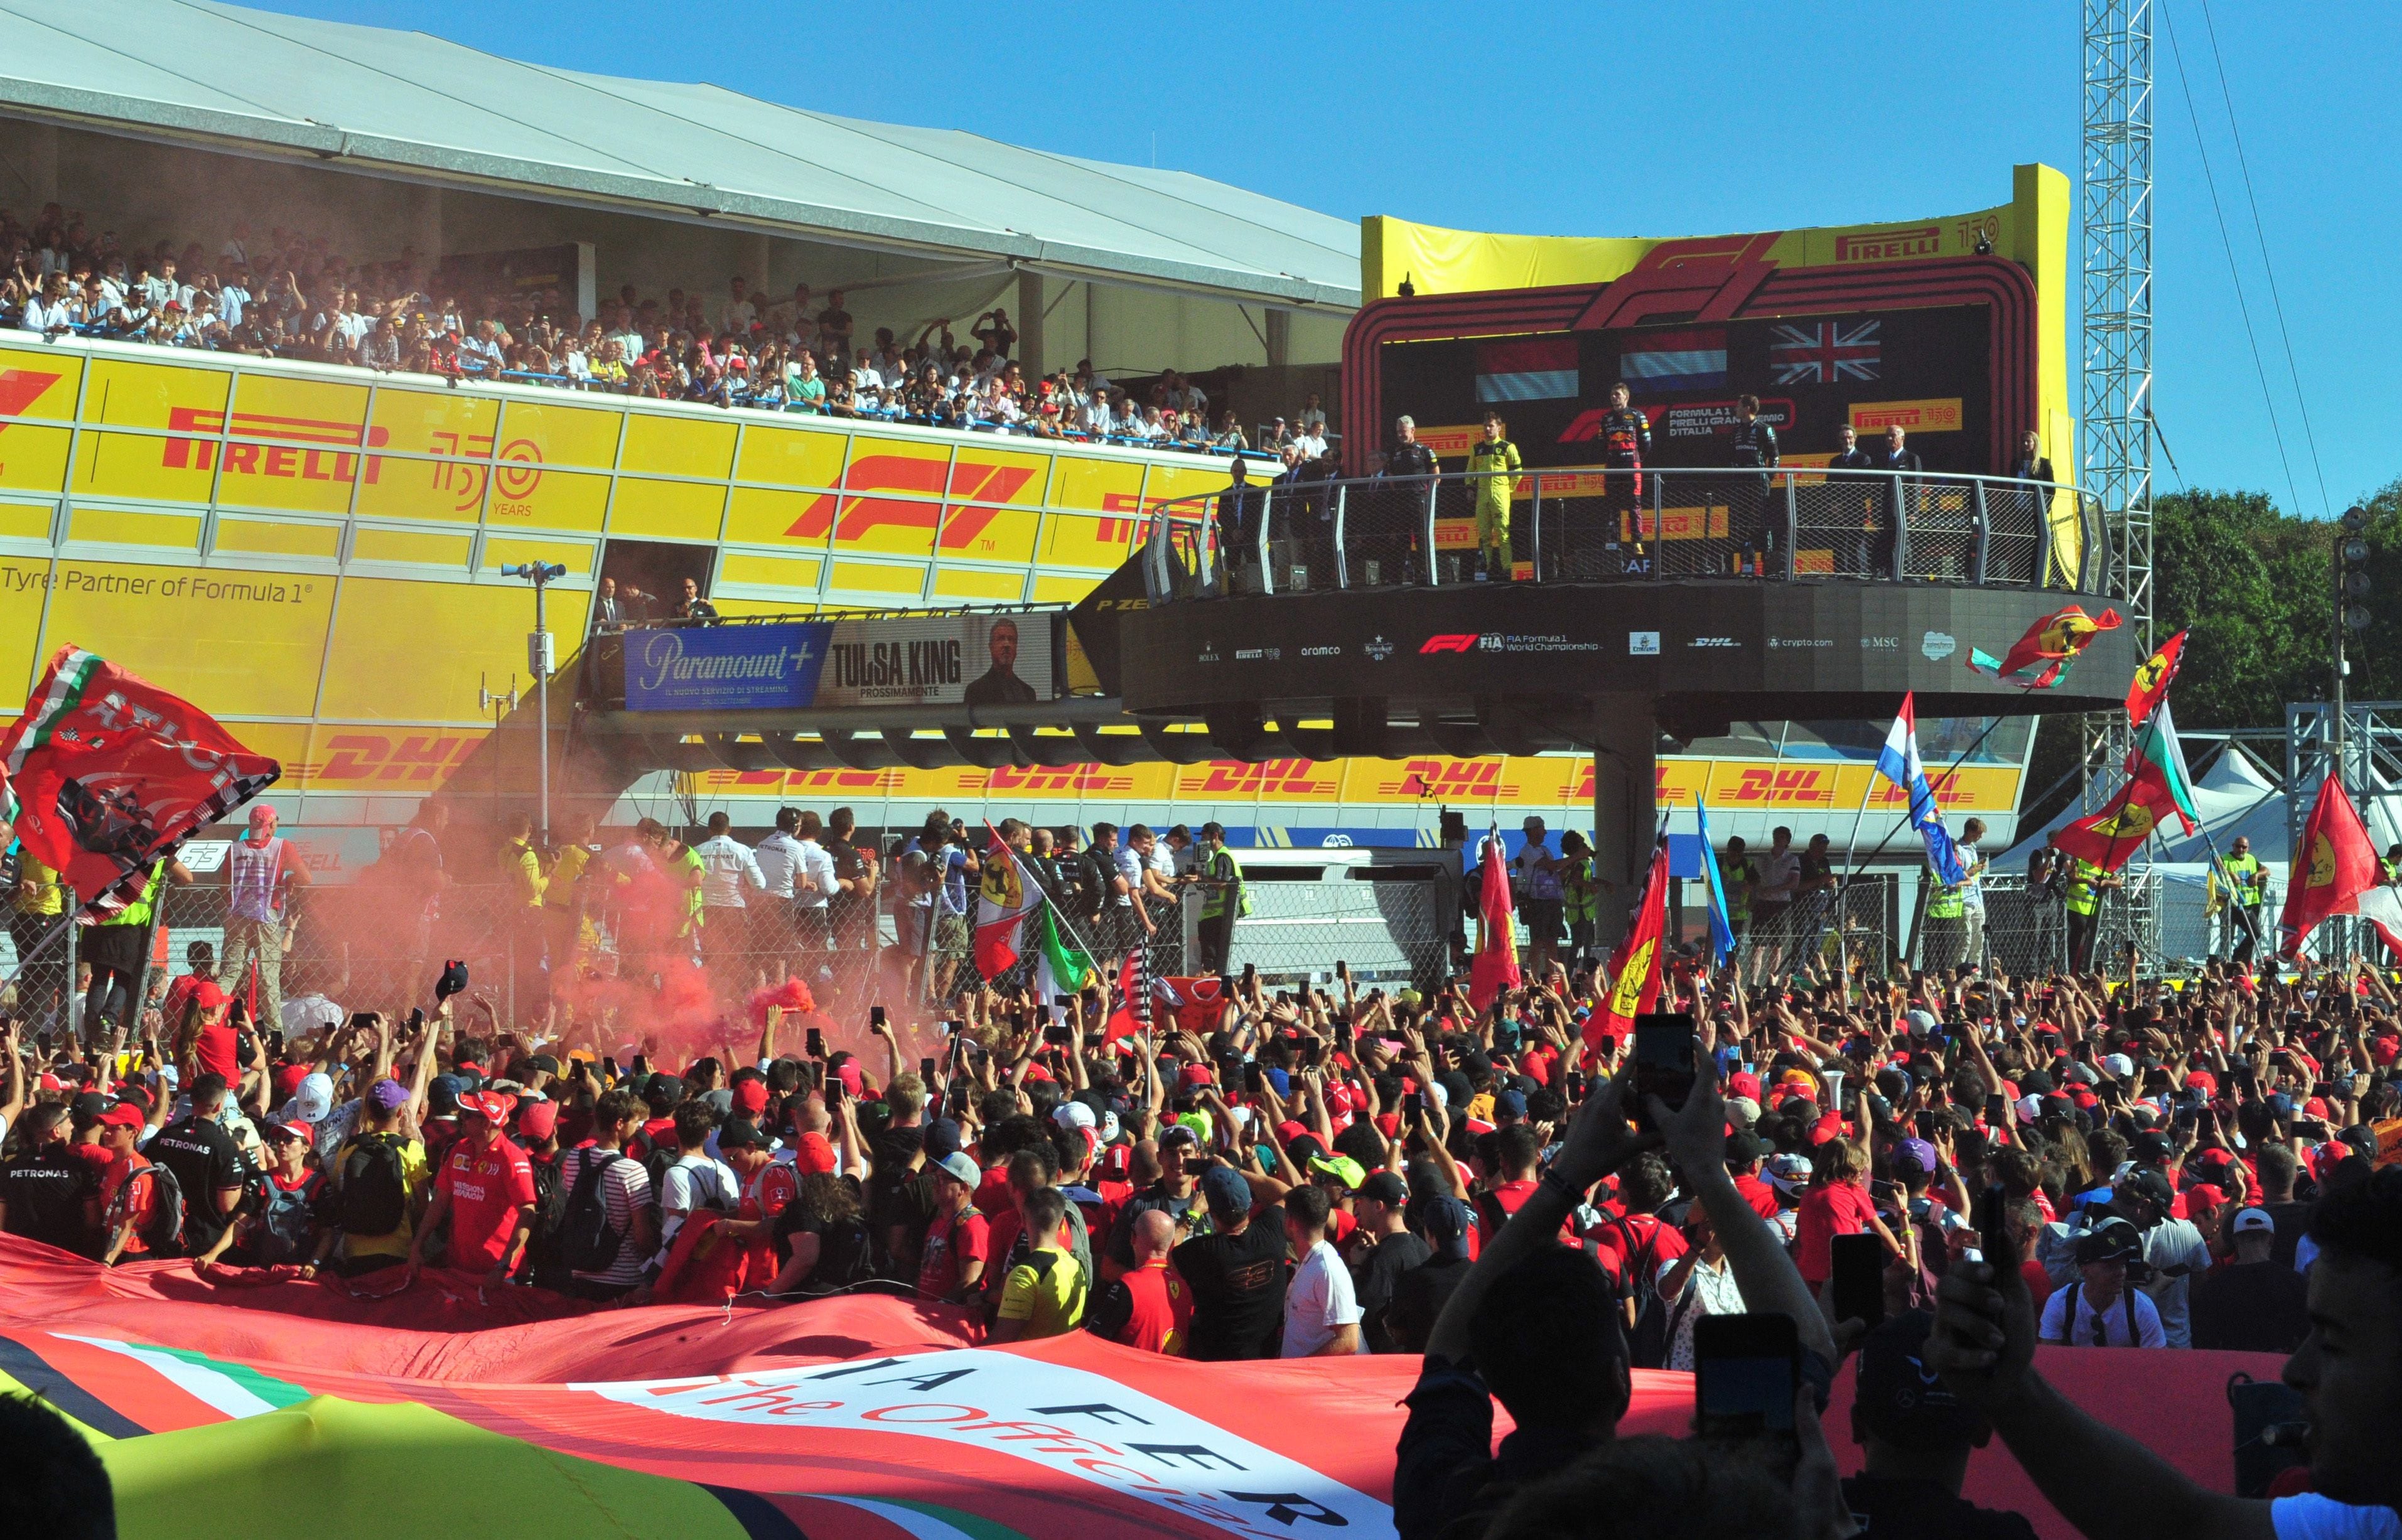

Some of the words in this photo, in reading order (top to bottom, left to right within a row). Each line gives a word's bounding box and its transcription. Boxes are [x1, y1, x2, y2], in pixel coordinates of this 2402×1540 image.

[1836, 227, 1940, 261] PIRELLI
[1669, 408, 1724, 419] FORMULA
[1725, 407, 1730, 416] 1
[1855, 409, 1920, 428] PIRELLI
[1925, 407, 1956, 424] 150
[1669, 418, 1709, 428] PIRELLI
[1710, 416, 1741, 426] GRAN
[1757, 413, 1785, 423] EMIO
[1669, 426, 1713, 437] D'ITALIA
[162, 406, 390, 485] PIRELLI
[429, 431, 544, 512] 150
[493, 503, 532, 516] YEARS
[981, 539, 995, 551] TM
[1, 567, 58, 591] Tyre
[65, 570, 155, 596] Partner
[161, 578, 186, 598] of
[191, 579, 285, 603] Formula
[1523, 635, 1559, 643] Formula
[1694, 638, 1735, 647] DHL
[1782, 639, 1833, 649] crypto.com
[1873, 637, 1899, 647] MSC
[1301, 646, 1340, 656] aramco
[1507, 643, 1533, 651] World
[1534, 643, 1598, 651] Championship
[1236, 649, 1263, 659] PIRELLI
[832, 642, 904, 687] TULSA
[908, 639, 961, 685] KING
[860, 686, 939, 698] PROSSIMAMENTE
[1201, 759, 1317, 792] DHL
[1398, 760, 1502, 796] DHL
[1737, 769, 1821, 802] DHL
[177, 841, 231, 871] 63
[159, 1137, 210, 1155] PETRONAS
[10, 1169, 69, 1178] PETRONAS
